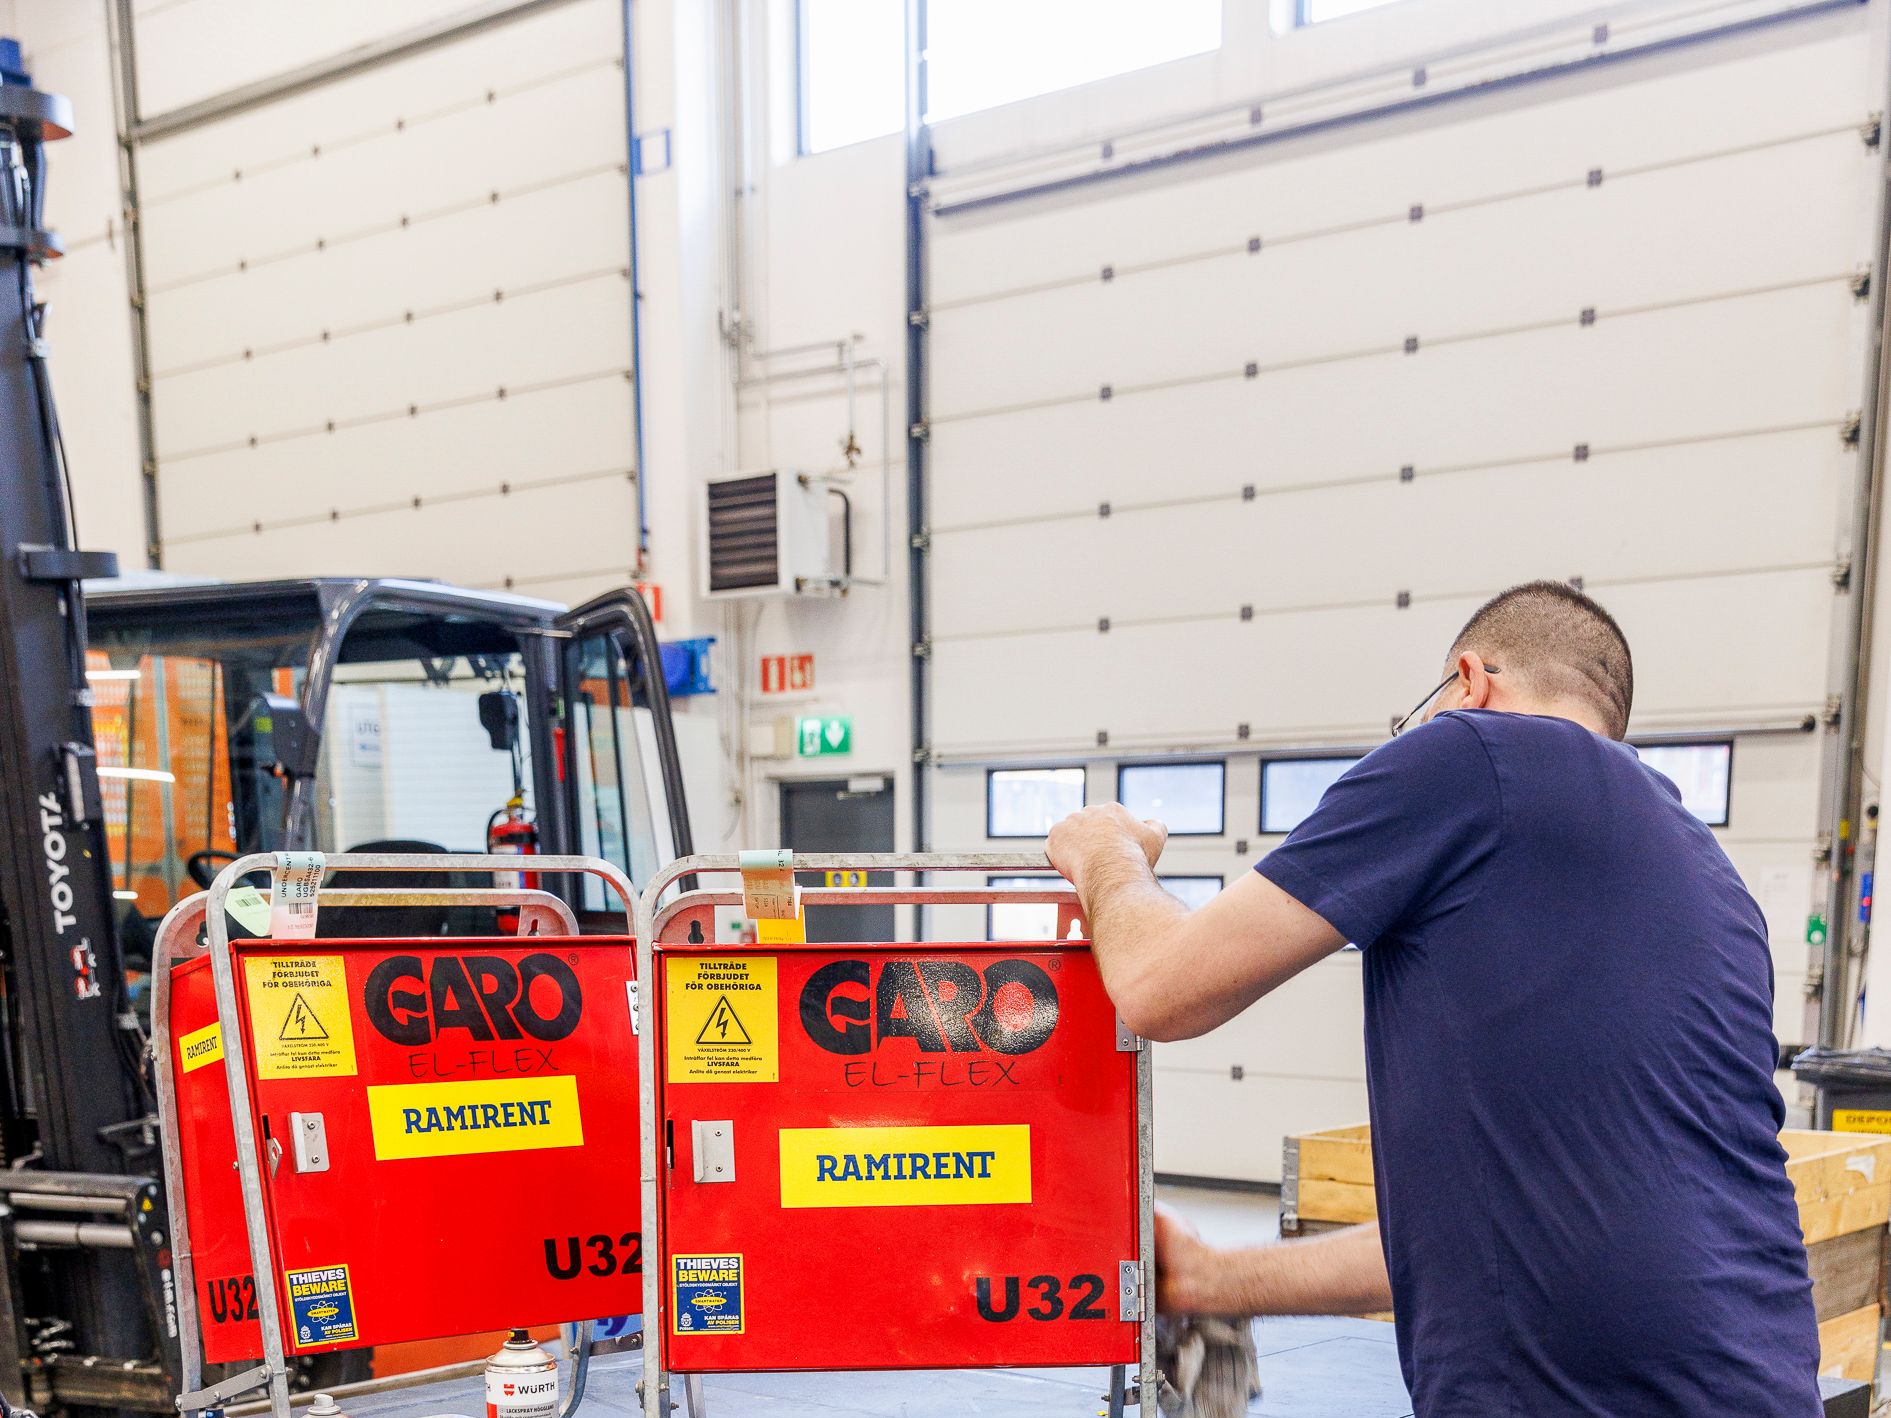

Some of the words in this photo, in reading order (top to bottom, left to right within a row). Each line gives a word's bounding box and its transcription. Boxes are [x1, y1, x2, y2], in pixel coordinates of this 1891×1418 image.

[39, 791, 76, 935] TOYOTA
[697, 971, 750, 980] FÖRBJUDET
[700, 961, 747, 970] TILLTRÄDE
[364, 953, 583, 1047] GARO
[685, 981, 703, 990] FÖR
[706, 981, 762, 991] OBEHÖRIGA
[799, 959, 1060, 1056] GARO
[186, 1036, 218, 1060] RAMIRENT
[408, 1048, 559, 1078] EL-FLEX
[844, 1060, 1021, 1088] EL-FLEX
[403, 1100, 551, 1134] RAMIRENT
[816, 1151, 996, 1182] RAMIRENT
[543, 1232, 643, 1281] U32
[677, 1258, 739, 1270] THIEVES
[290, 1268, 345, 1285] THIEVES
[292, 1280, 347, 1297] BEWARE
[678, 1269, 738, 1282] BEWARE
[208, 1275, 260, 1323] U32
[976, 1274, 1106, 1323] U32
